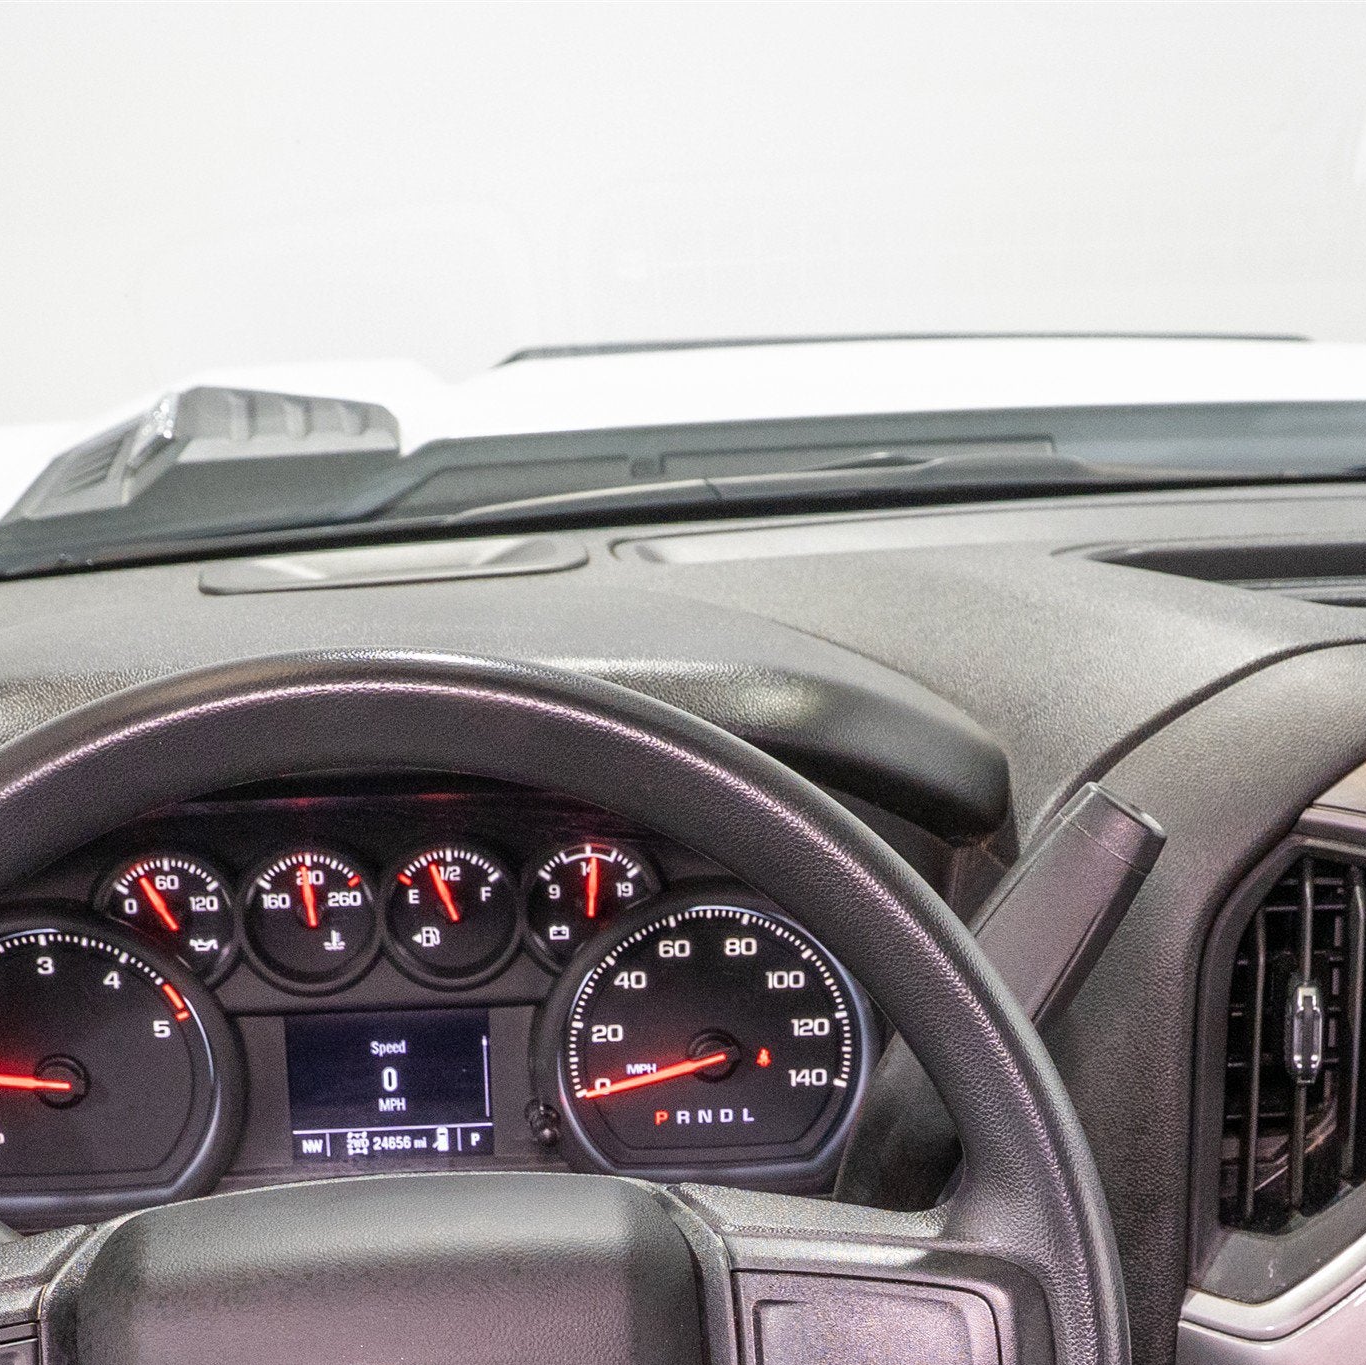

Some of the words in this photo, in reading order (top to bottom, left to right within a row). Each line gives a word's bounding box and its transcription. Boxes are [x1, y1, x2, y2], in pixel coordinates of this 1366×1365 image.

[155, 875, 179, 890] 60
[616, 882, 634, 898] 19
[327, 891, 362, 907] 260
[408, 889, 420, 904] E
[480, 887, 492, 902] F
[548, 884, 561, 899] 9
[124, 898, 138, 915] 0
[190, 896, 218, 912] 120
[262, 893, 291, 910] 160
[658, 939, 691, 958] 60
[725, 937, 757, 956] 80
[36, 956, 55, 975] 3
[103, 970, 121, 989] 4
[613, 971, 647, 989] 40
[765, 970, 805, 989] 100
[152, 1020, 171, 1038] 5
[591, 1024, 623, 1042] 20
[790, 1018, 830, 1037] 120
[370, 1040, 407, 1057] Speed
[626, 1063, 657, 1075] MPH
[382, 1067, 398, 1092] 0
[788, 1069, 828, 1087] 140
[378, 1097, 406, 1111] MPH
[655, 1110, 669, 1125] P
[676, 1109, 690, 1124] R
[697, 1109, 713, 1124] N
[720, 1108, 733, 1123] D
[742, 1108, 755, 1122] L
[302, 1139, 323, 1154] NW
[373, 1136, 412, 1150] 24656
[413, 1137, 427, 1149] mi
[470, 1132, 480, 1146] P
